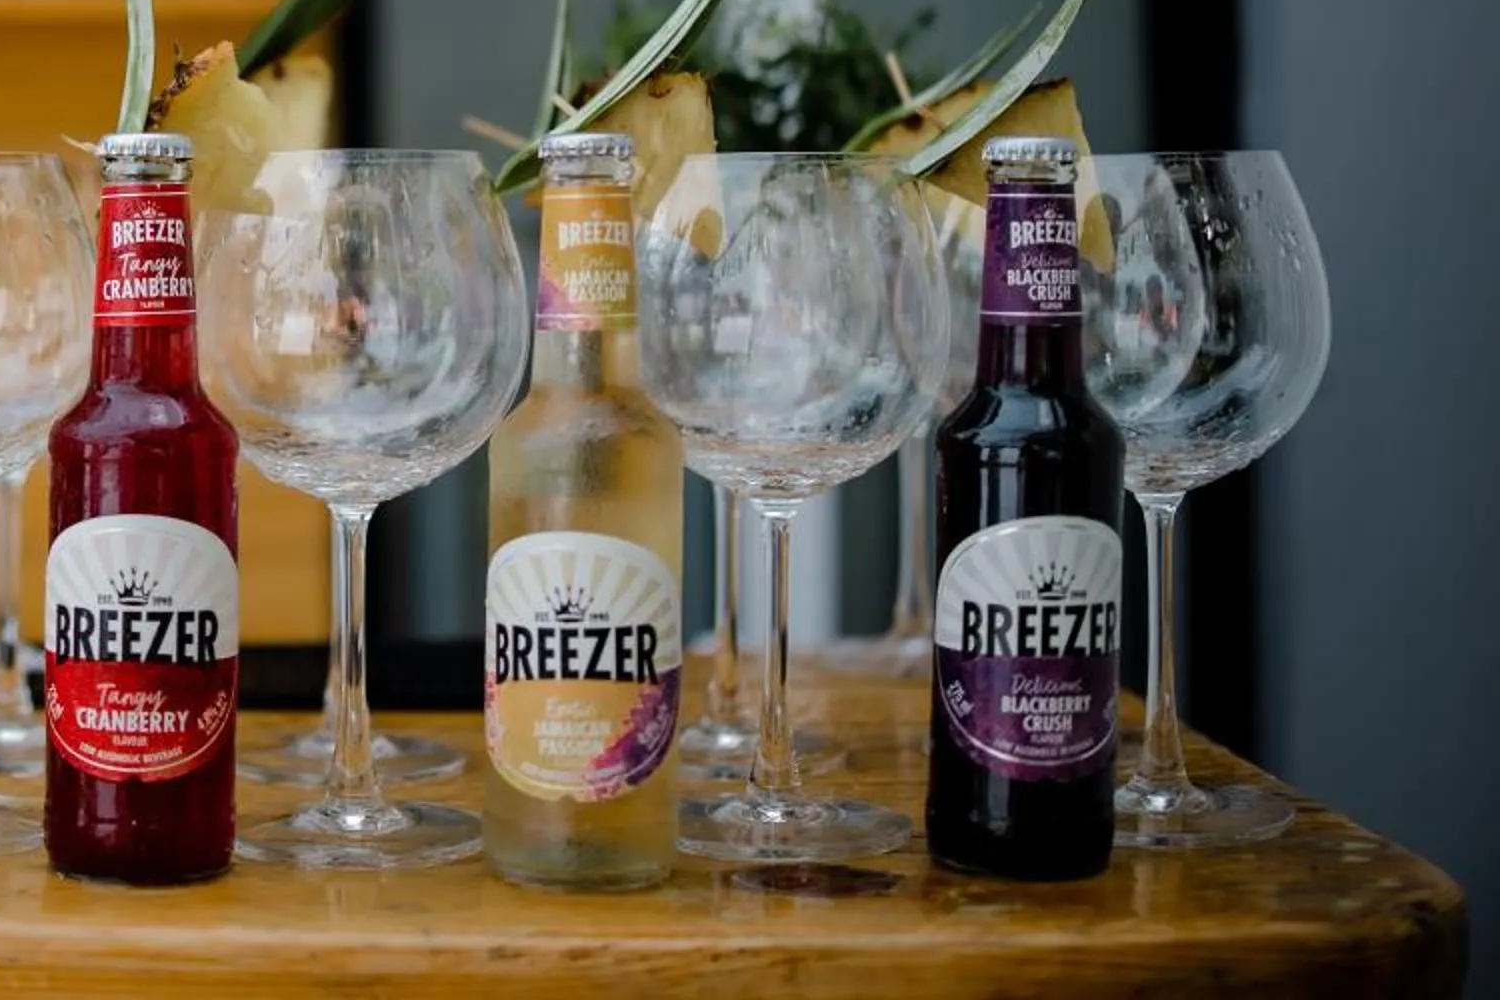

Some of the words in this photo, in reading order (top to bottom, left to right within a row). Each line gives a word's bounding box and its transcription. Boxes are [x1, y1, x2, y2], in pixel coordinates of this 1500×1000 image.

[112, 219, 185, 248] BREEZER
[558, 220, 630, 249] BREEZER
[117, 252, 183, 279] Tangy
[103, 278, 194, 300] CRANBERRY
[1028, 285, 1071, 301] CRUSH
[56, 604, 219, 667] BREEZER
[962, 601, 1116, 661] BREEZER
[496, 623, 658, 685] BREEZER
[96, 682, 167, 713] Tangy
[1001, 695, 1091, 713] BLACKBERRY
[75, 707, 190, 733] CRANBERRY
[1022, 713, 1073, 732] CRUSH
